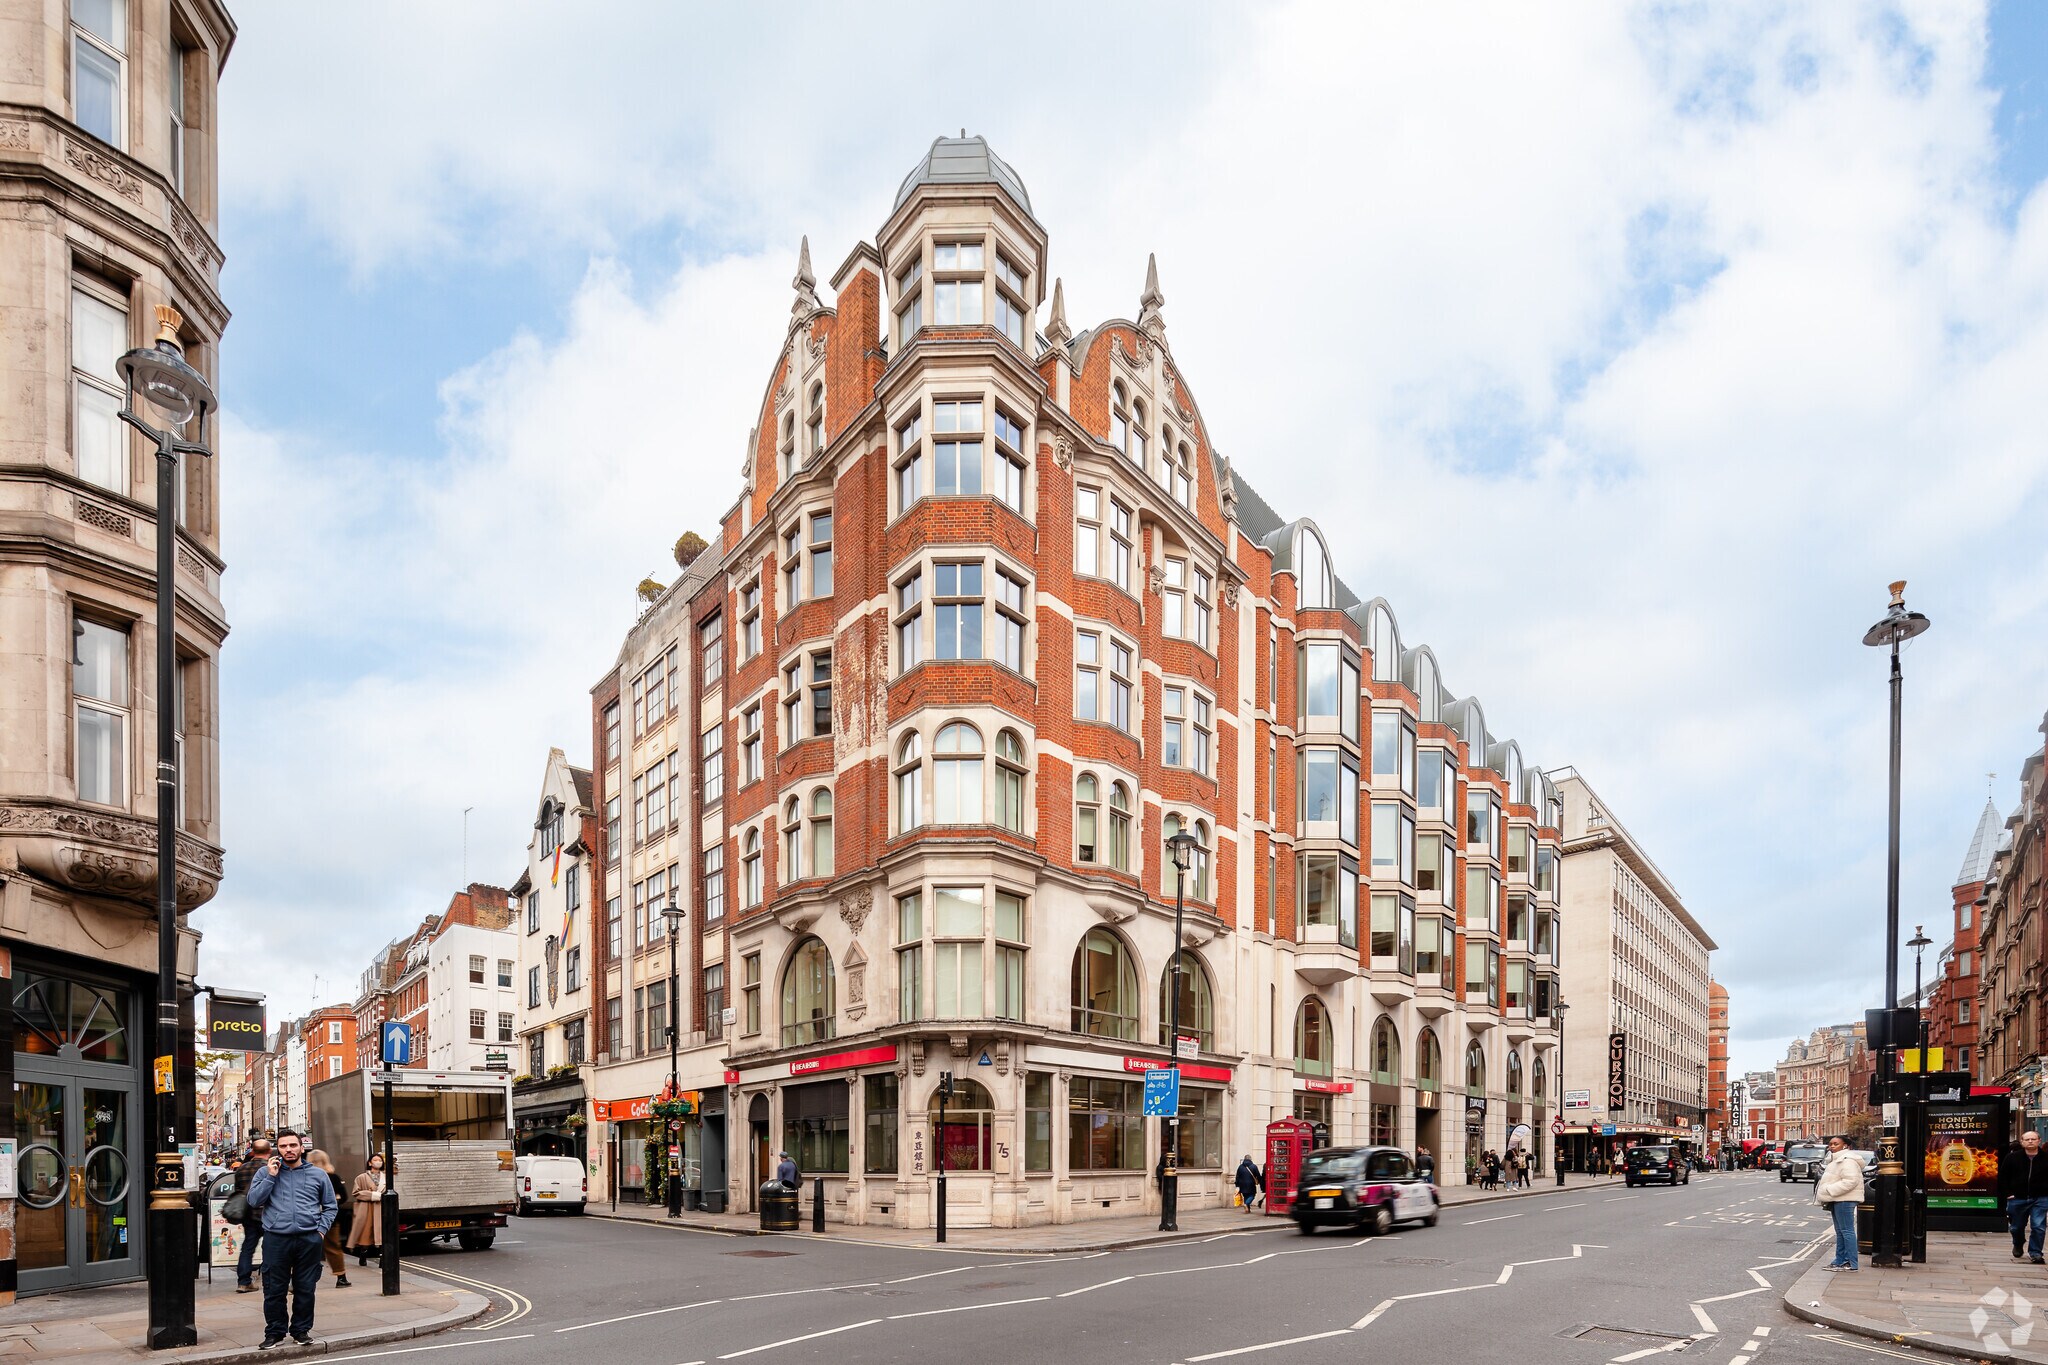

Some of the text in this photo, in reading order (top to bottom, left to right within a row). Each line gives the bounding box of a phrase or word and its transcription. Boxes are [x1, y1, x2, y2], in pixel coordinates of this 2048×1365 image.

[213, 1020, 261, 1033] preto
[1610, 1036, 1623, 1106] CURZON
[1732, 1082, 1740, 1126] PALACE
[913, 1131, 923, 1171] 東亞銀行
[996, 1143, 1009, 1158] 75
